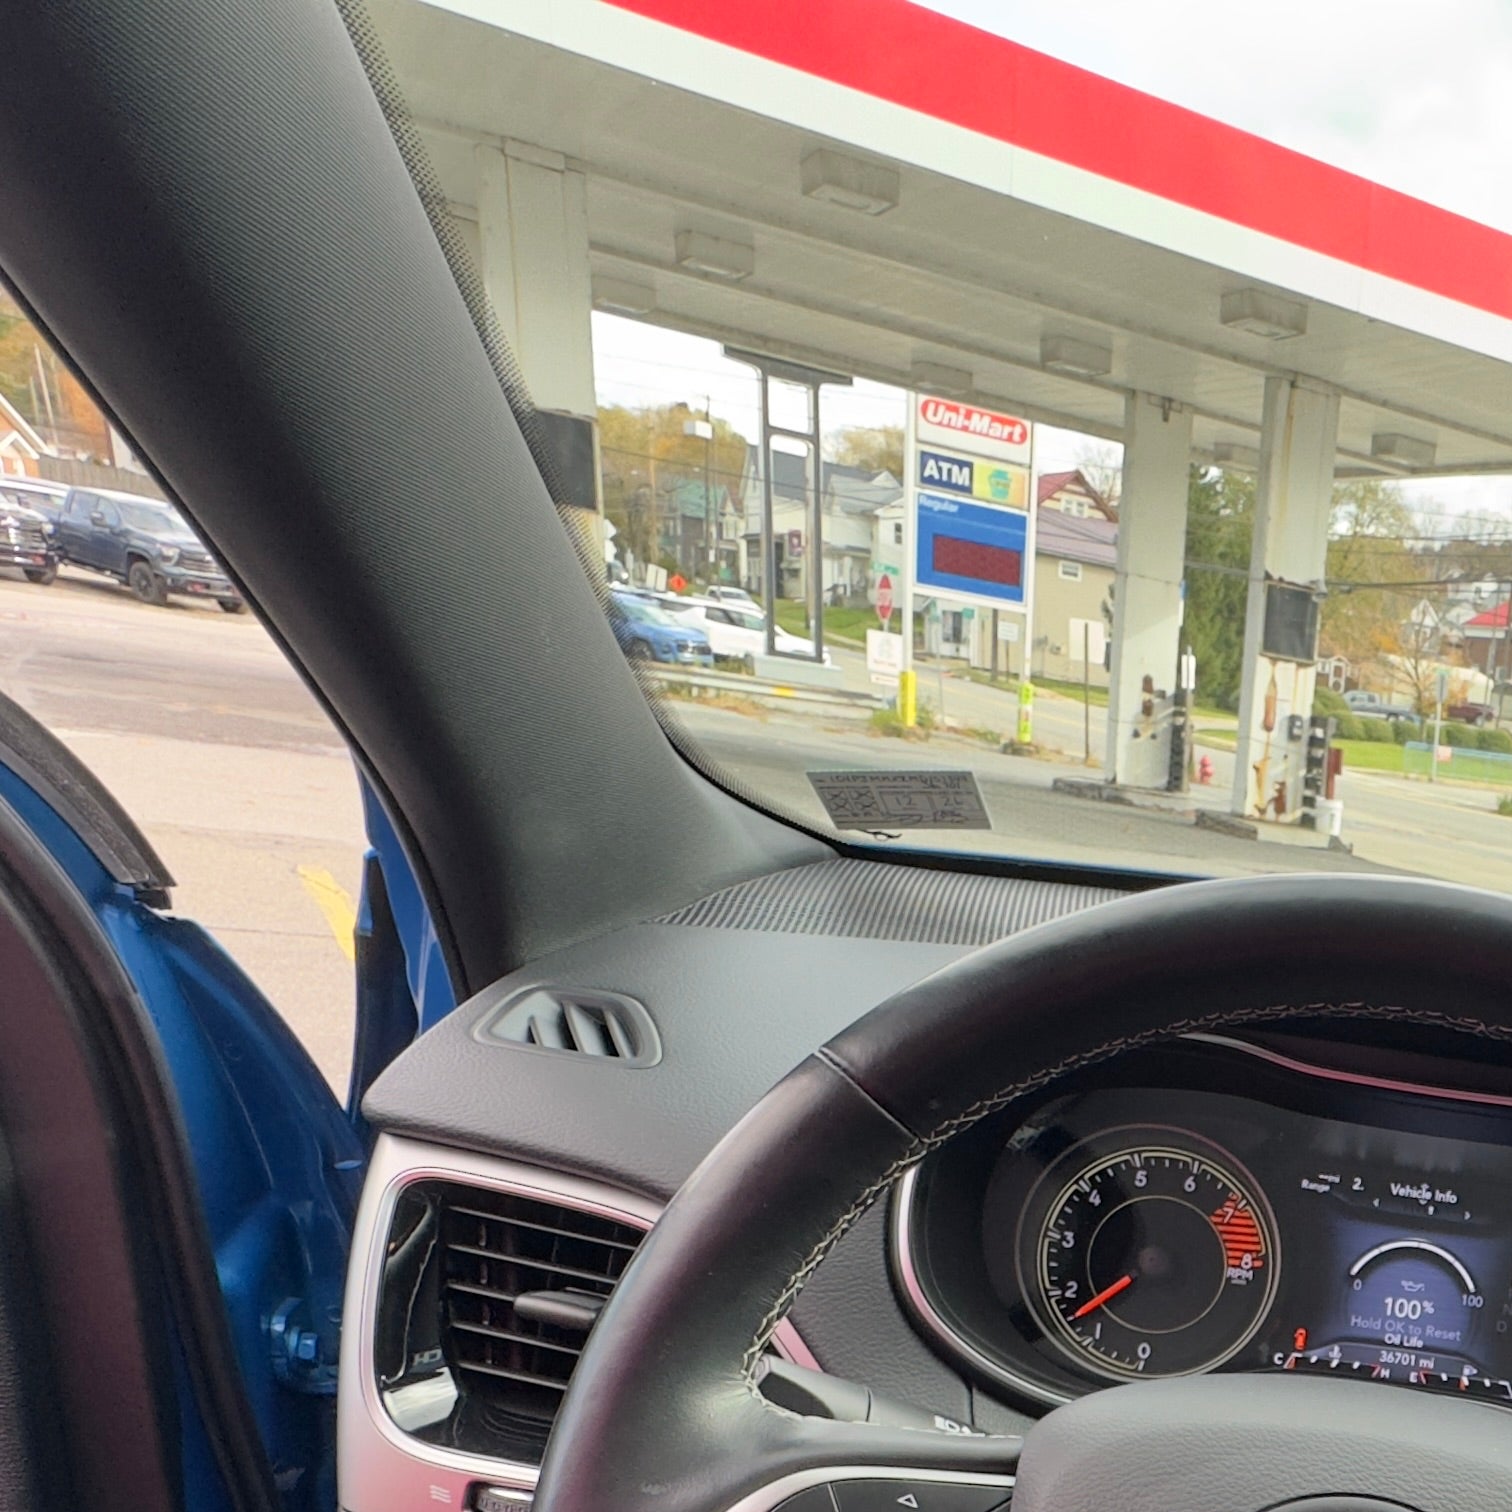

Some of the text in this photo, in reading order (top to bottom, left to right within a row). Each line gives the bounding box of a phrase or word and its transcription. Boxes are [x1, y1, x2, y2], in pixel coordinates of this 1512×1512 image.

[925, 401, 1023, 443] Uni-Mart
[923, 458, 970, 487] ATM
[1135, 1171, 1147, 1187] 5
[1184, 1176, 1196, 1192] 6
[1089, 1190, 1101, 1206] 4
[1390, 1182, 1458, 1204] Vehicle Info
[1223, 1206, 1234, 1223] 7
[1062, 1232, 1075, 1248] 3
[1240, 1253, 1252, 1268] 8
[1226, 1268, 1253, 1281] RPM
[1065, 1281, 1078, 1298] 2
[1353, 1280, 1362, 1291] 0
[1384, 1297, 1435, 1320] 100%
[1461, 1294, 1484, 1308] 100
[1350, 1315, 1461, 1341] Hold OK to Reset
[1384, 1333, 1424, 1348] Oil Life
[1138, 1343, 1151, 1359] 0
[1273, 1353, 1284, 1366] C
[1380, 1350, 1435, 1369] 36701 mi
[1380, 1368, 1390, 1379] H
[1409, 1371, 1418, 1383] E
